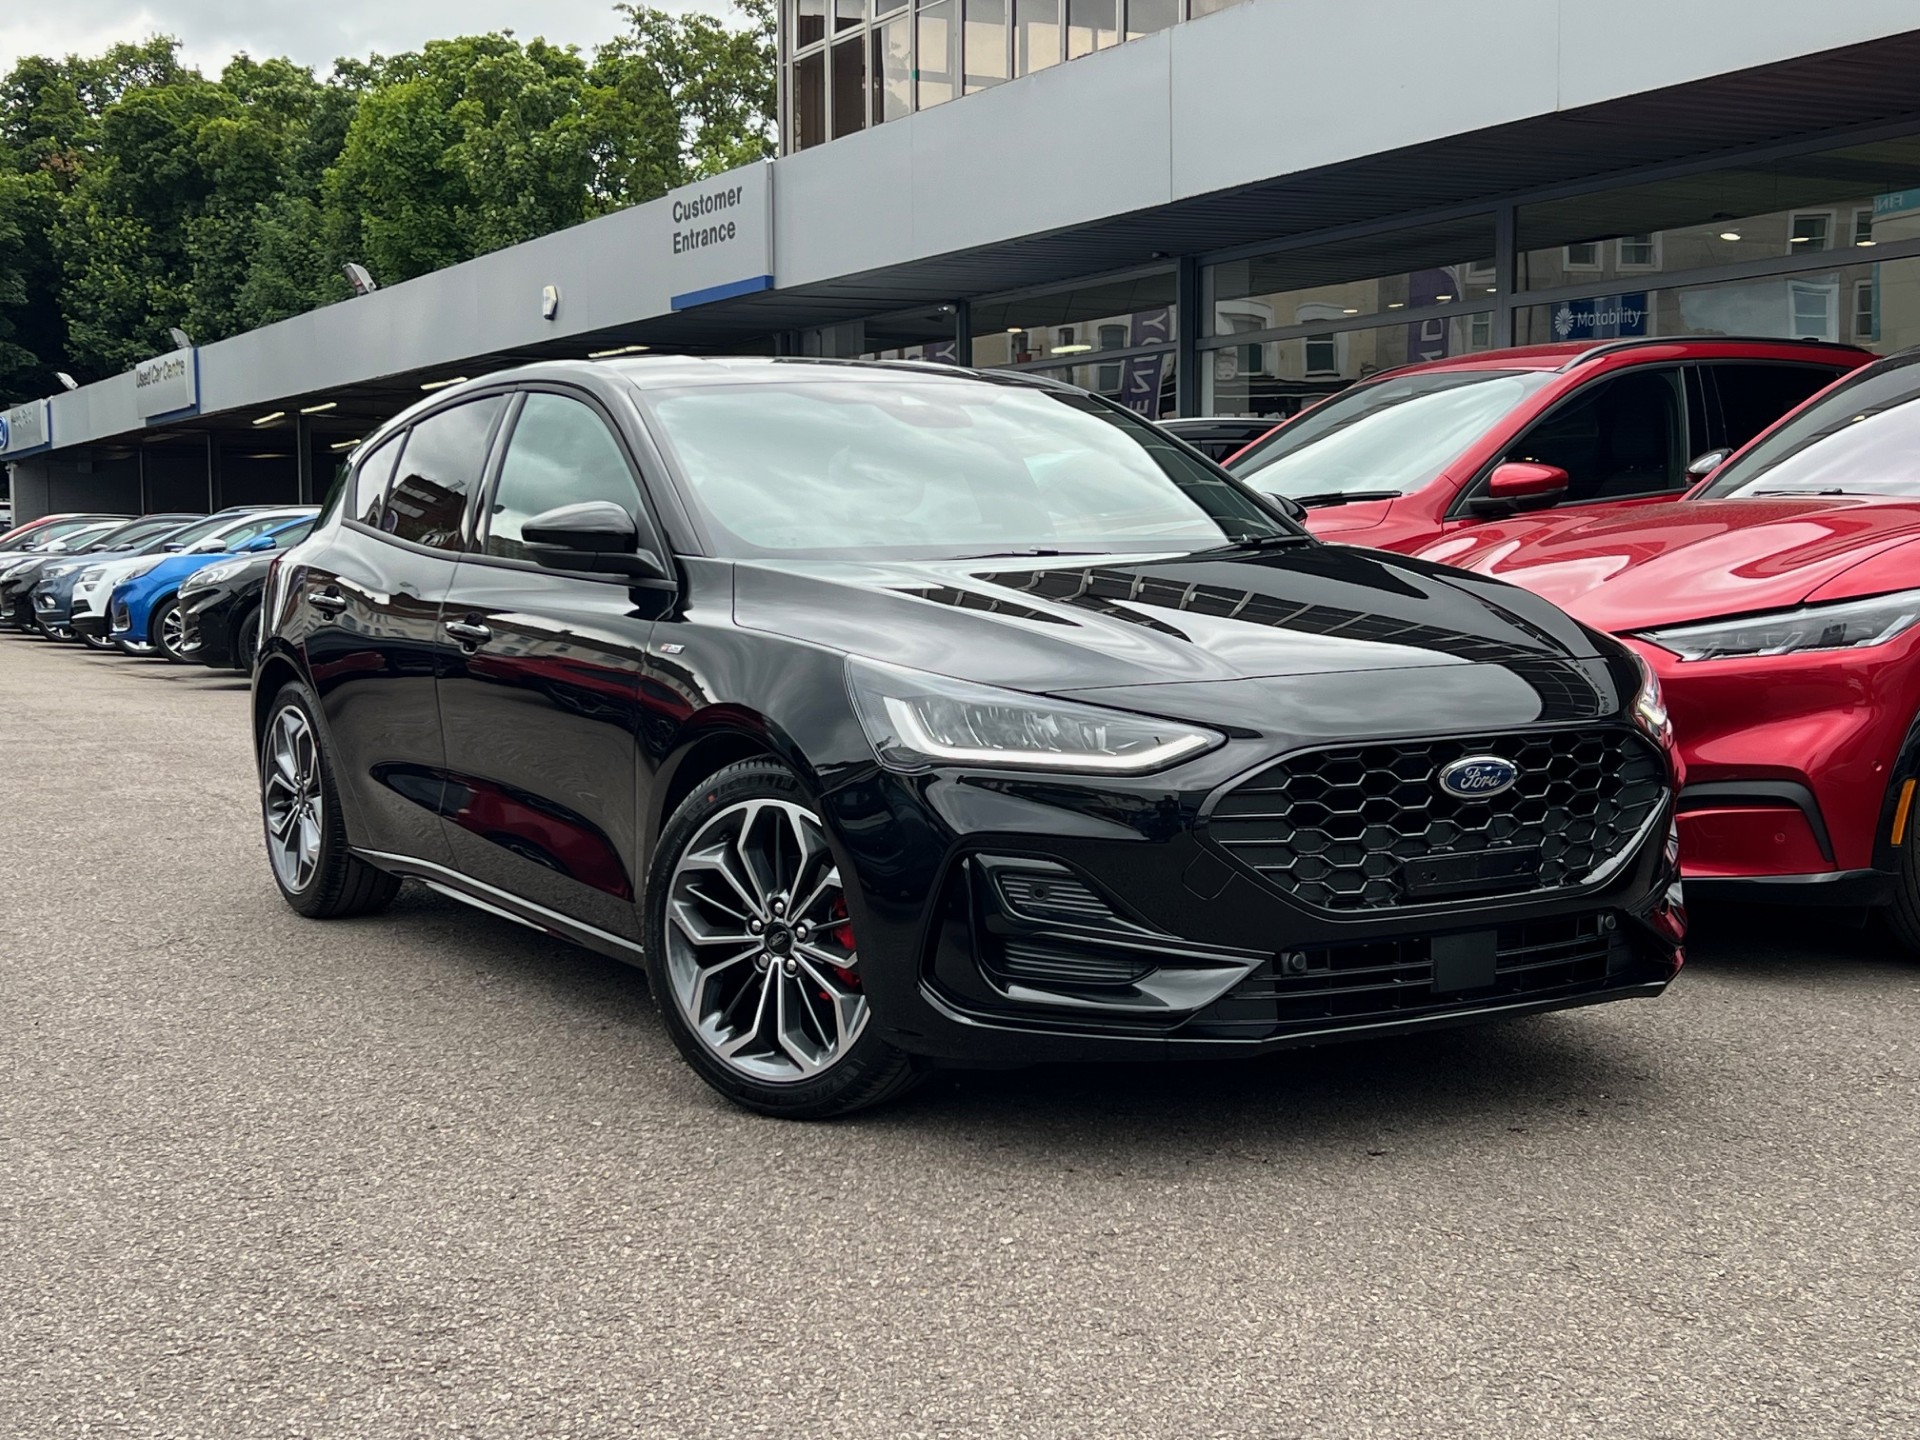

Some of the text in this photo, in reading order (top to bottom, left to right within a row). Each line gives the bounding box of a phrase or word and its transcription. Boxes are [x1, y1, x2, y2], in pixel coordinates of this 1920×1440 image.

[673, 186, 742, 223] Customer
[673, 221, 736, 254] Entrance
[1577, 307, 1641, 328] Motability
[136, 359, 185, 389] Used Car Centre
[1460, 765, 1502, 790] Ford
